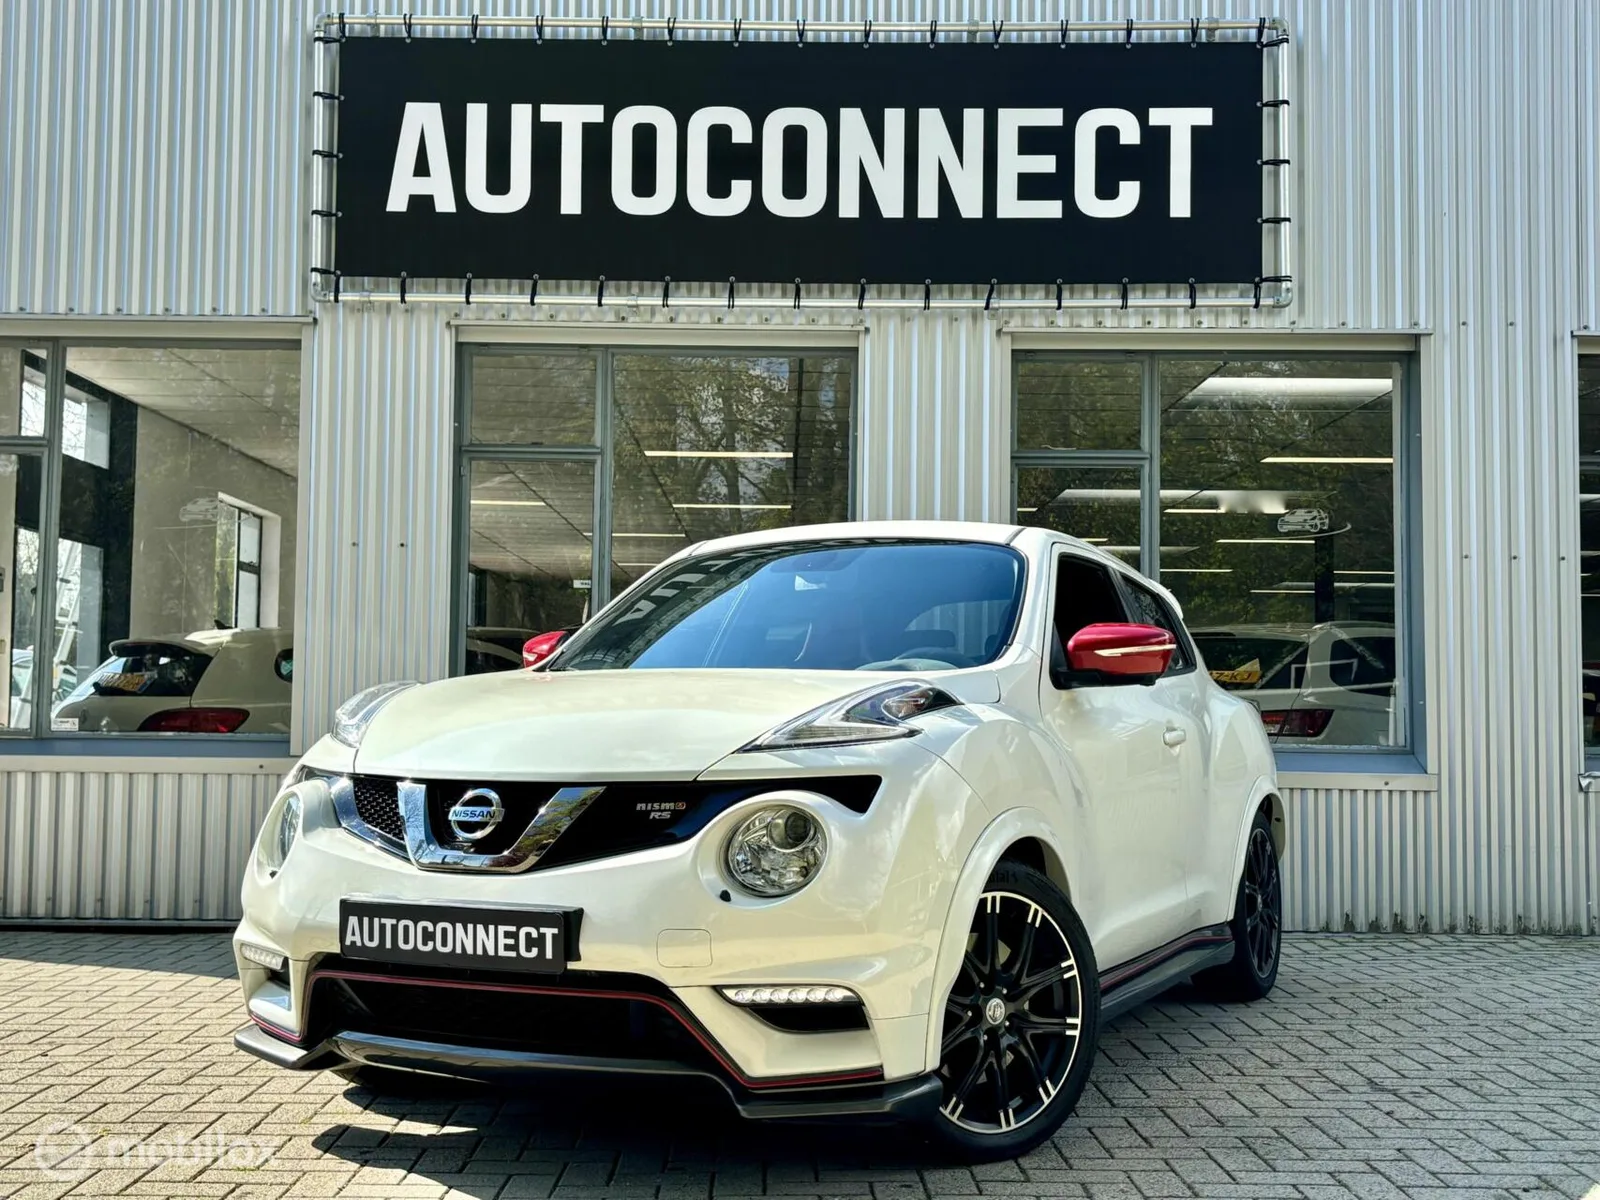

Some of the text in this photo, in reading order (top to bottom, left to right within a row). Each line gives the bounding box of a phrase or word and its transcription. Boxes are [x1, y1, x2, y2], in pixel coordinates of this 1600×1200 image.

[385, 101, 1213, 219] AUTOCONNECT
[452, 809, 496, 819] NISSAN
[649, 811, 672, 820] RS
[344, 915, 559, 960] AUTOCONNECT
